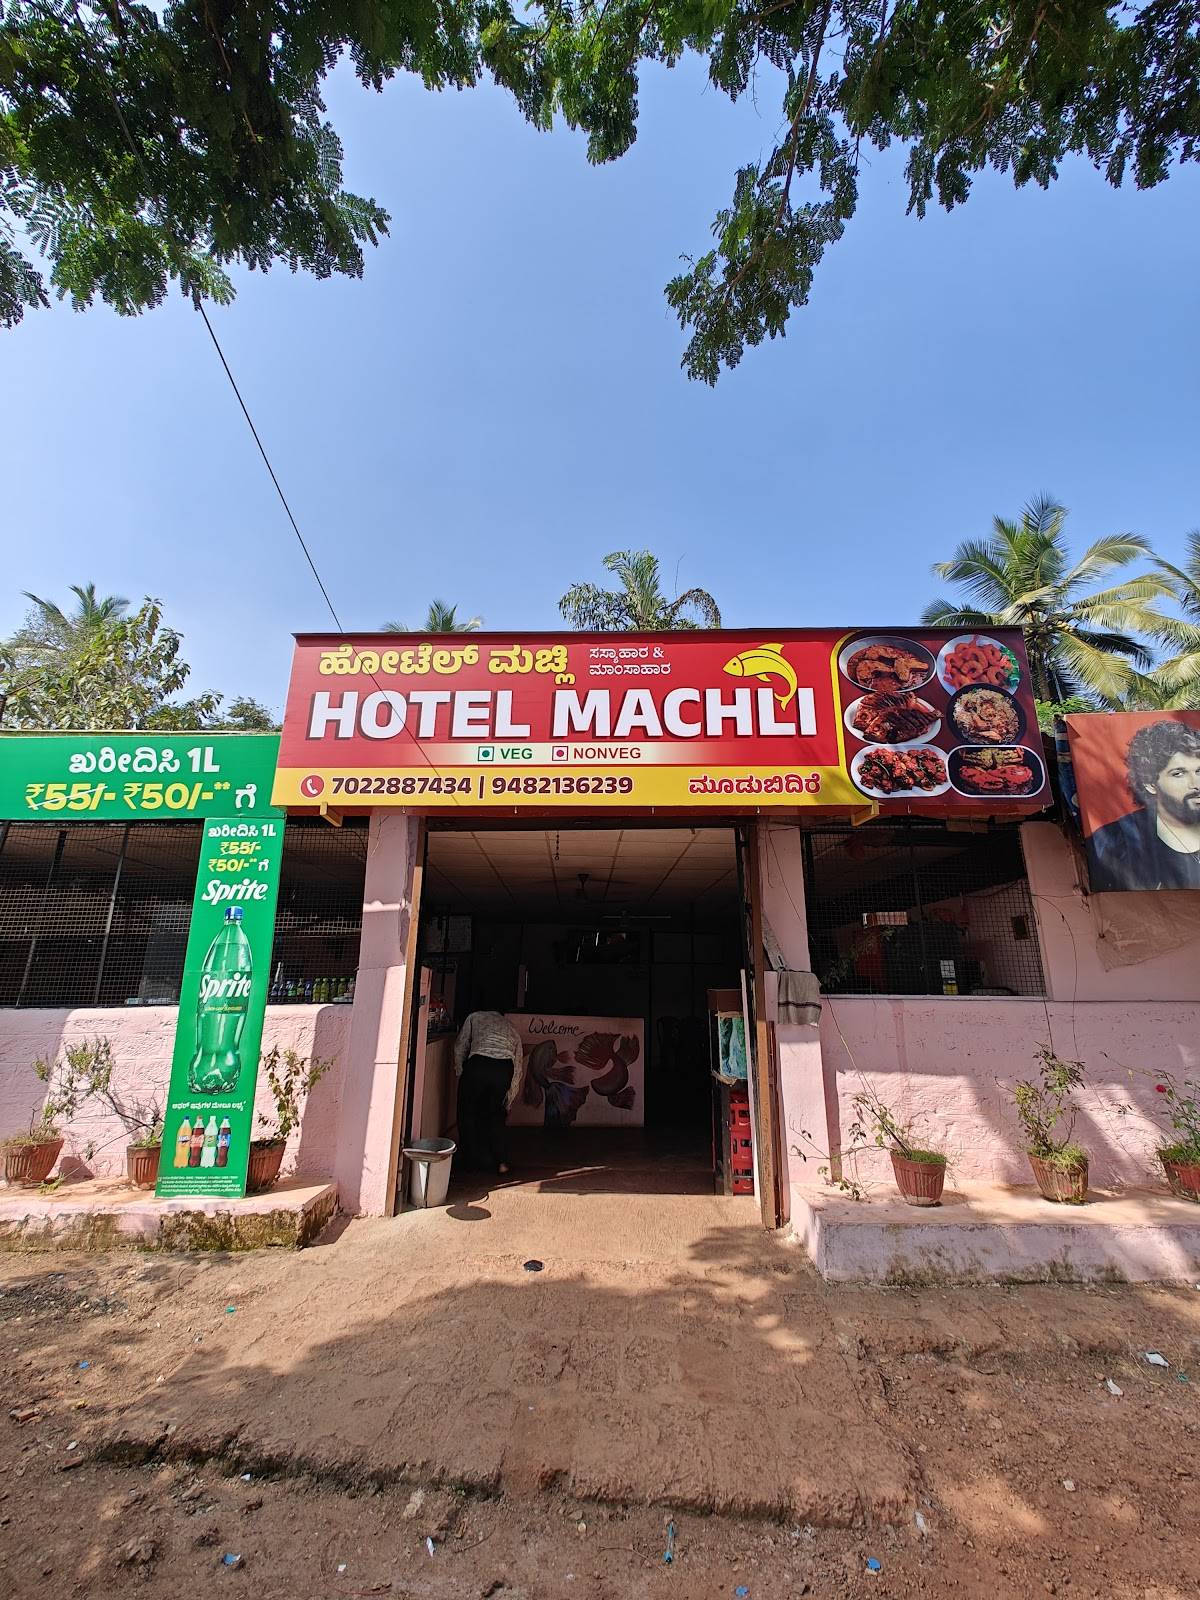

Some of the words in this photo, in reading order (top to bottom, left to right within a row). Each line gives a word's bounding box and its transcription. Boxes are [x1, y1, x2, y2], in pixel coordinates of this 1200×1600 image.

[318, 643, 480, 676] ಹೋಟೆಲ್
[589, 647, 649, 663] ಸಸ್ಯಾಹಾರ
[652, 647, 664, 658] &
[589, 663, 671, 675] ಮಾಂಸಾಹಾರ
[308, 689, 531, 739] HOTEL
[552, 687, 818, 738] MACHLI
[68, 746, 181, 773] ಖರೀದಿಸಿ
[187, 747, 220, 773] 1L
[500, 747, 533, 760] VEG
[573, 747, 641, 760] NONVEG
[331, 775, 472, 795] 7022887434
[492, 775, 634, 795] 9482136239
[689, 773, 821, 795] ಮೂಡುಬಿದಿರೆ
[261, 824, 276, 837] 1L
[202, 878, 269, 905] Sprite
[200, 972, 251, 1003] Sprite
[528, 1017, 584, 1036] Welcome
